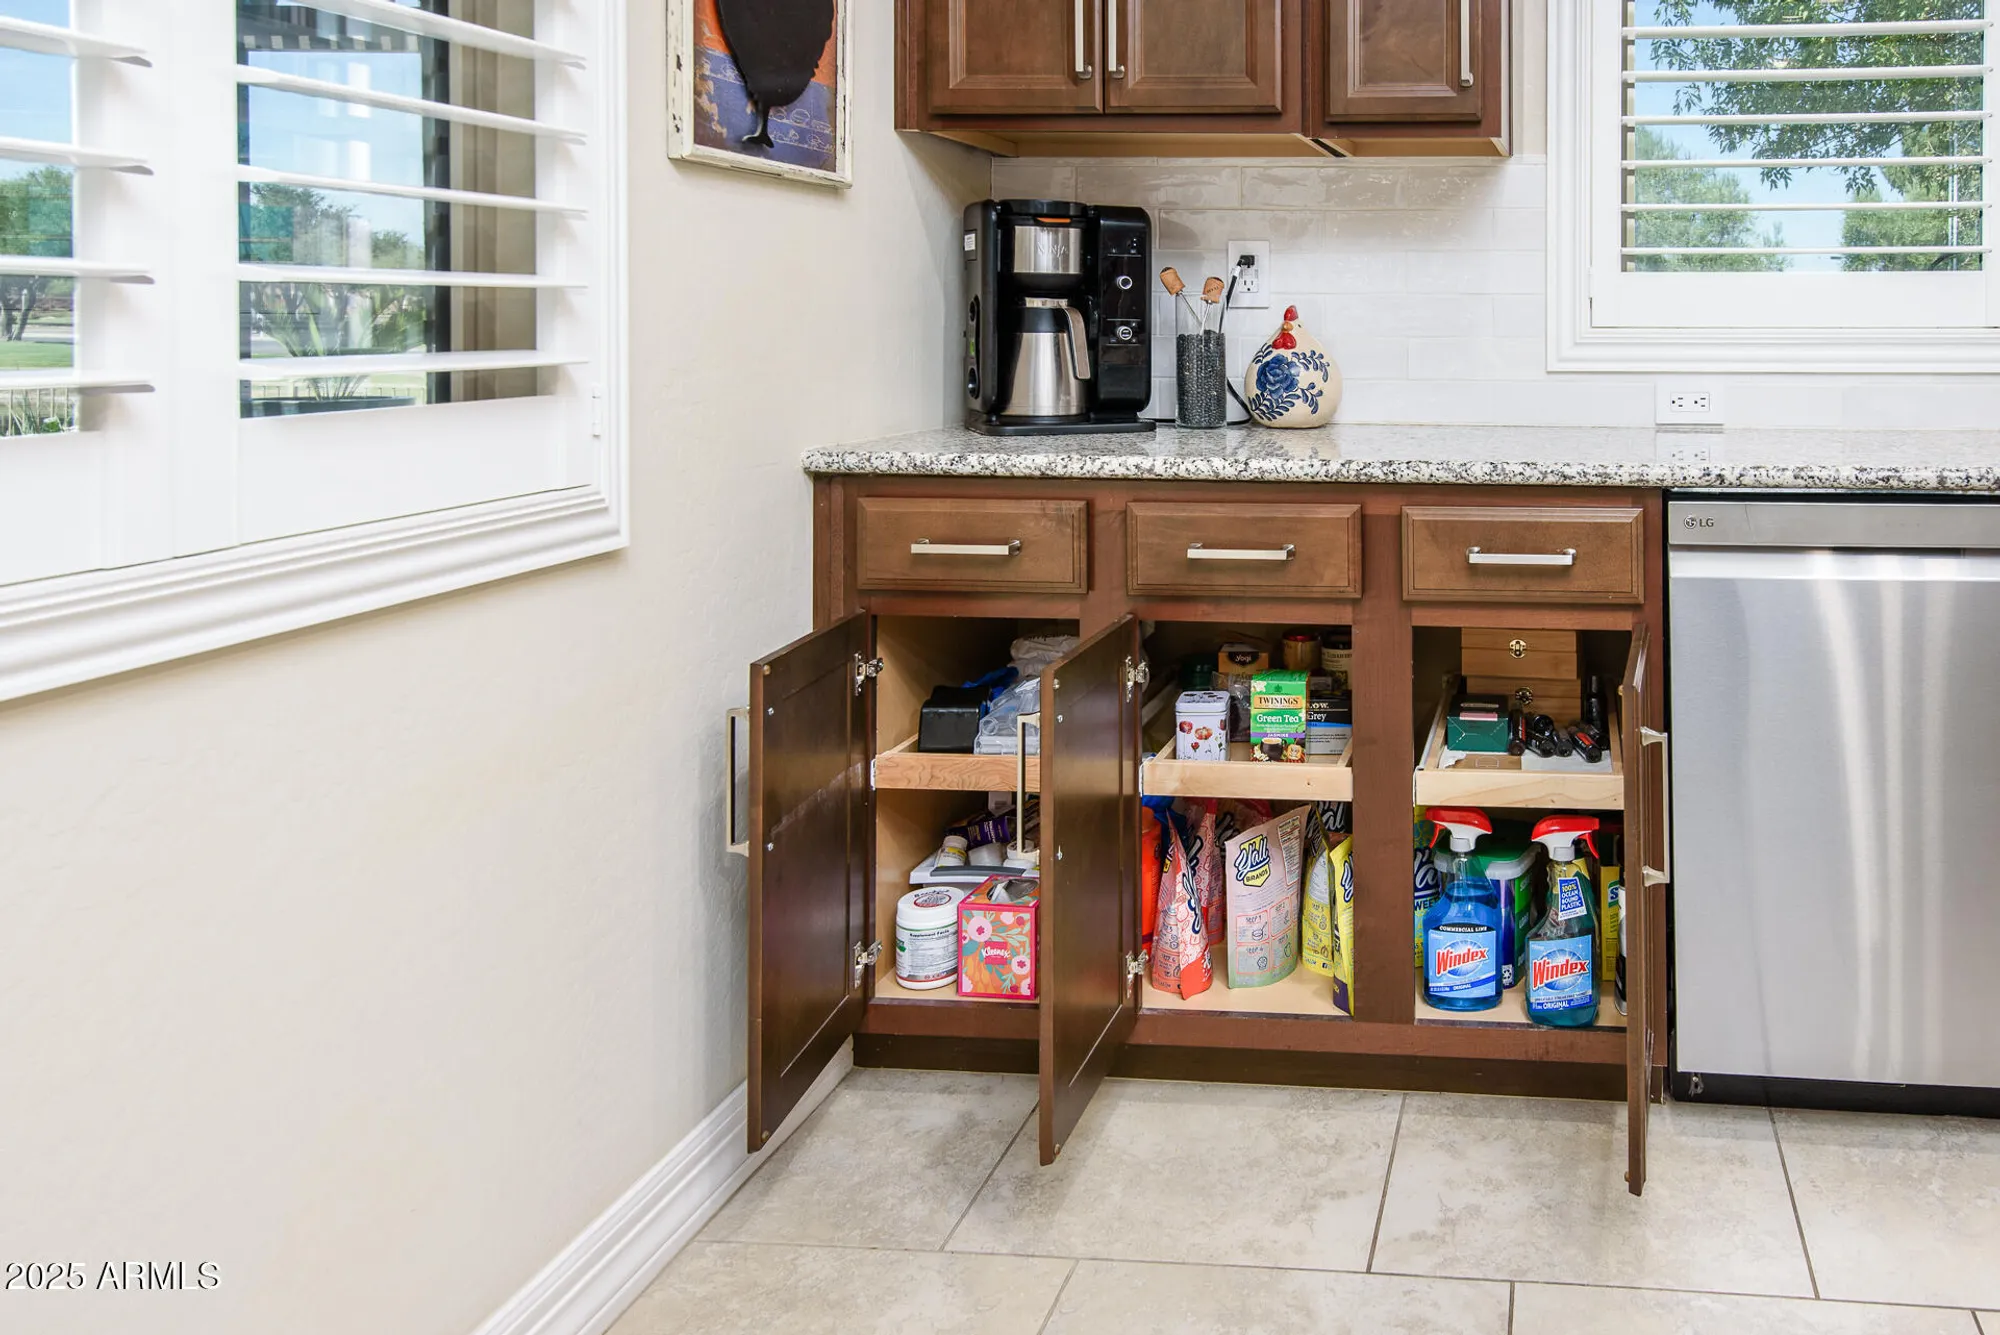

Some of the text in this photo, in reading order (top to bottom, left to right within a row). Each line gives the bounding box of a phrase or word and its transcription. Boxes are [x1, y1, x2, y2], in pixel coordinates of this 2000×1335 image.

[1699, 518, 1714, 527] LG
[1258, 696, 1299, 705] TWININGS
[1256, 714, 1299, 723] Green Tea
[1245, 868, 1269, 882] BRANDS
[1561, 884, 1577, 892] 100%
[1561, 890, 1579, 898] OCEAN
[1561, 896, 1579, 904] BOUND
[1561, 900, 1582, 910] PLASTIC
[980, 946, 1011, 959] Kleenex
[1436, 948, 1488, 976] Windex
[1533, 958, 1588, 989] Windex
[1542, 1000, 1570, 1009] ORIGINAL
